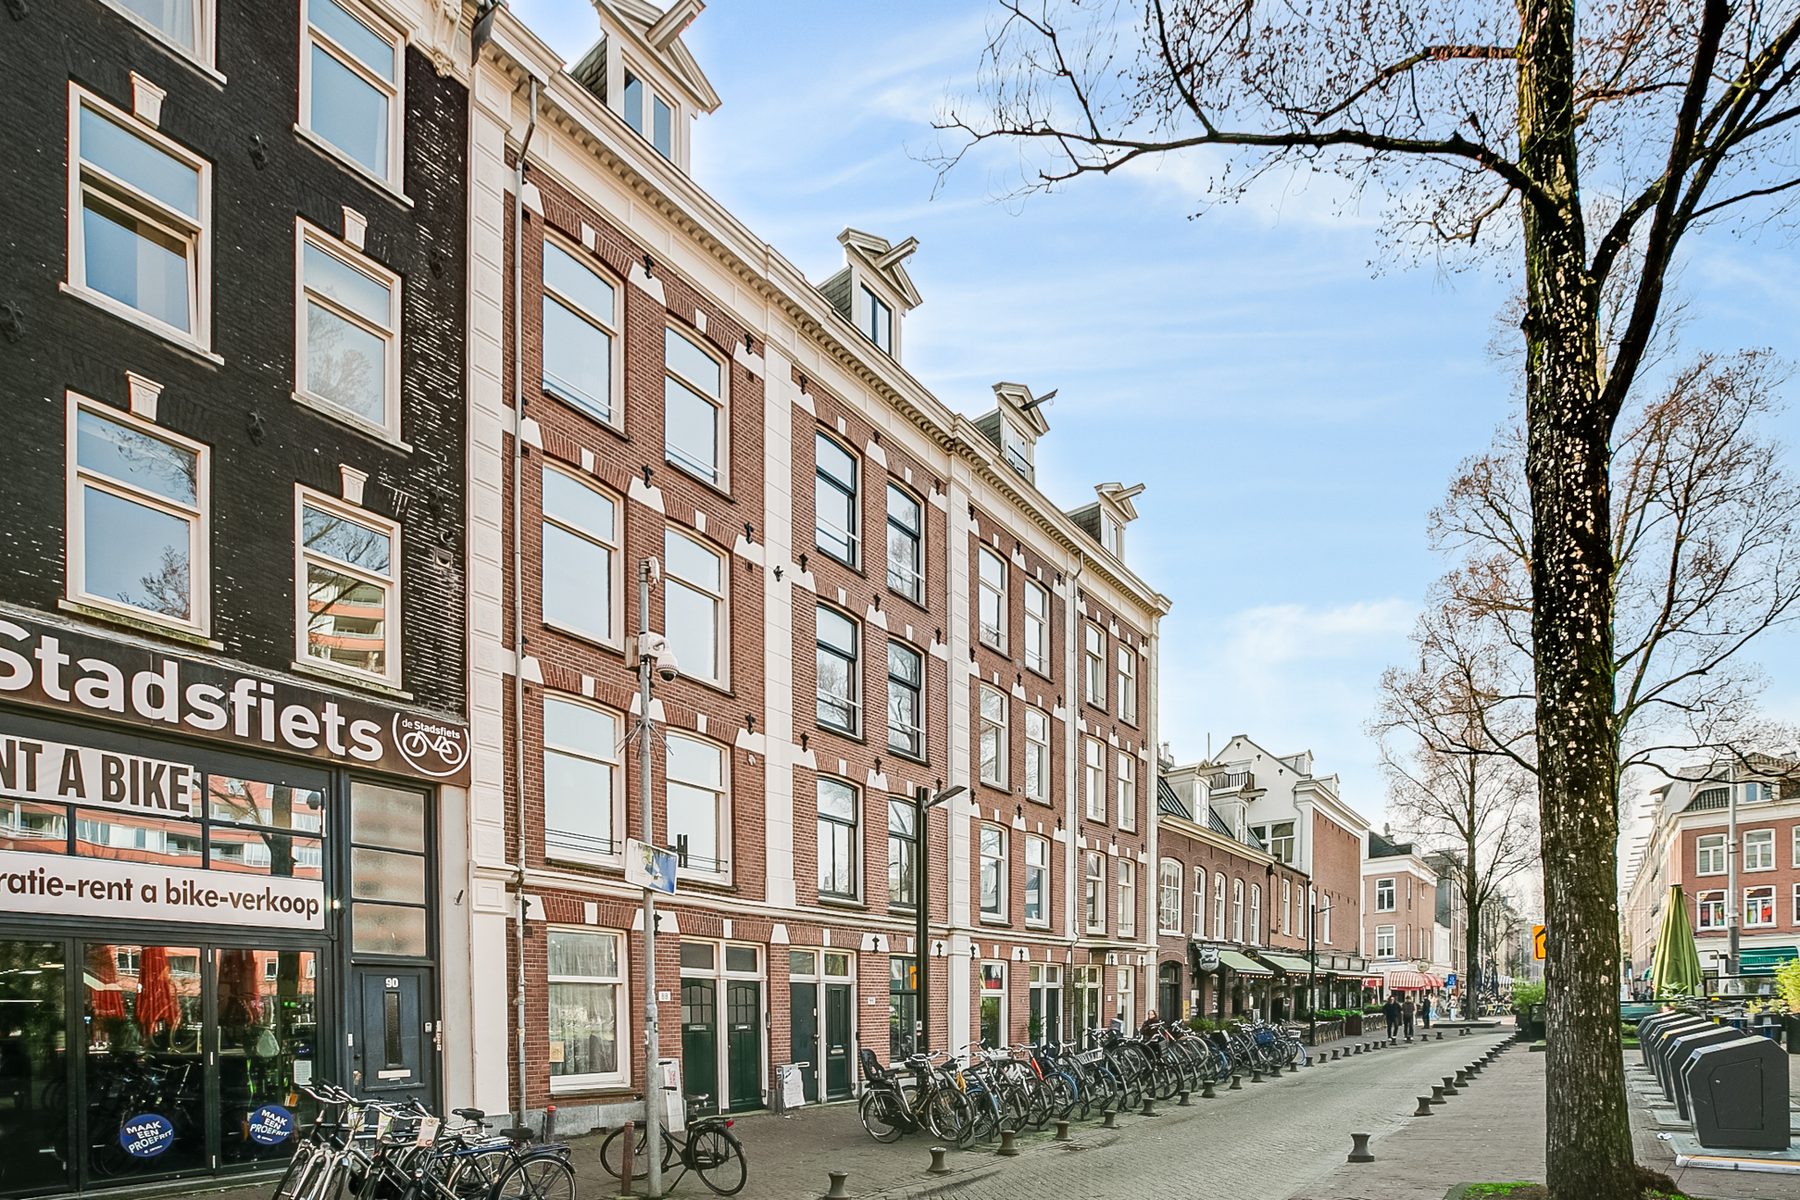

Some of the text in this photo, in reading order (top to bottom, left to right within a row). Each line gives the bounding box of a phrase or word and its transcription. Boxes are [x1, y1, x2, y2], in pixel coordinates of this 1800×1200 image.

[0, 620, 384, 762] Stadsfiets
[402, 719, 461, 739] de Stadsfiets
[58, 748, 86, 798] A
[102, 754, 190, 812] BIKE
[141, 883, 157, 904] a
[166, 878, 319, 920] bike-verkoop
[385, 977, 399, 988] 90
[261, 1109, 288, 1126] MAAK
[264, 1117, 281, 1130] EEN
[126, 1121, 162, 1134] MAAK
[137, 1129, 159, 1139] EEN
[250, 1123, 290, 1137] PROEFRIT
[128, 1128, 173, 1153] PROEFRIT
